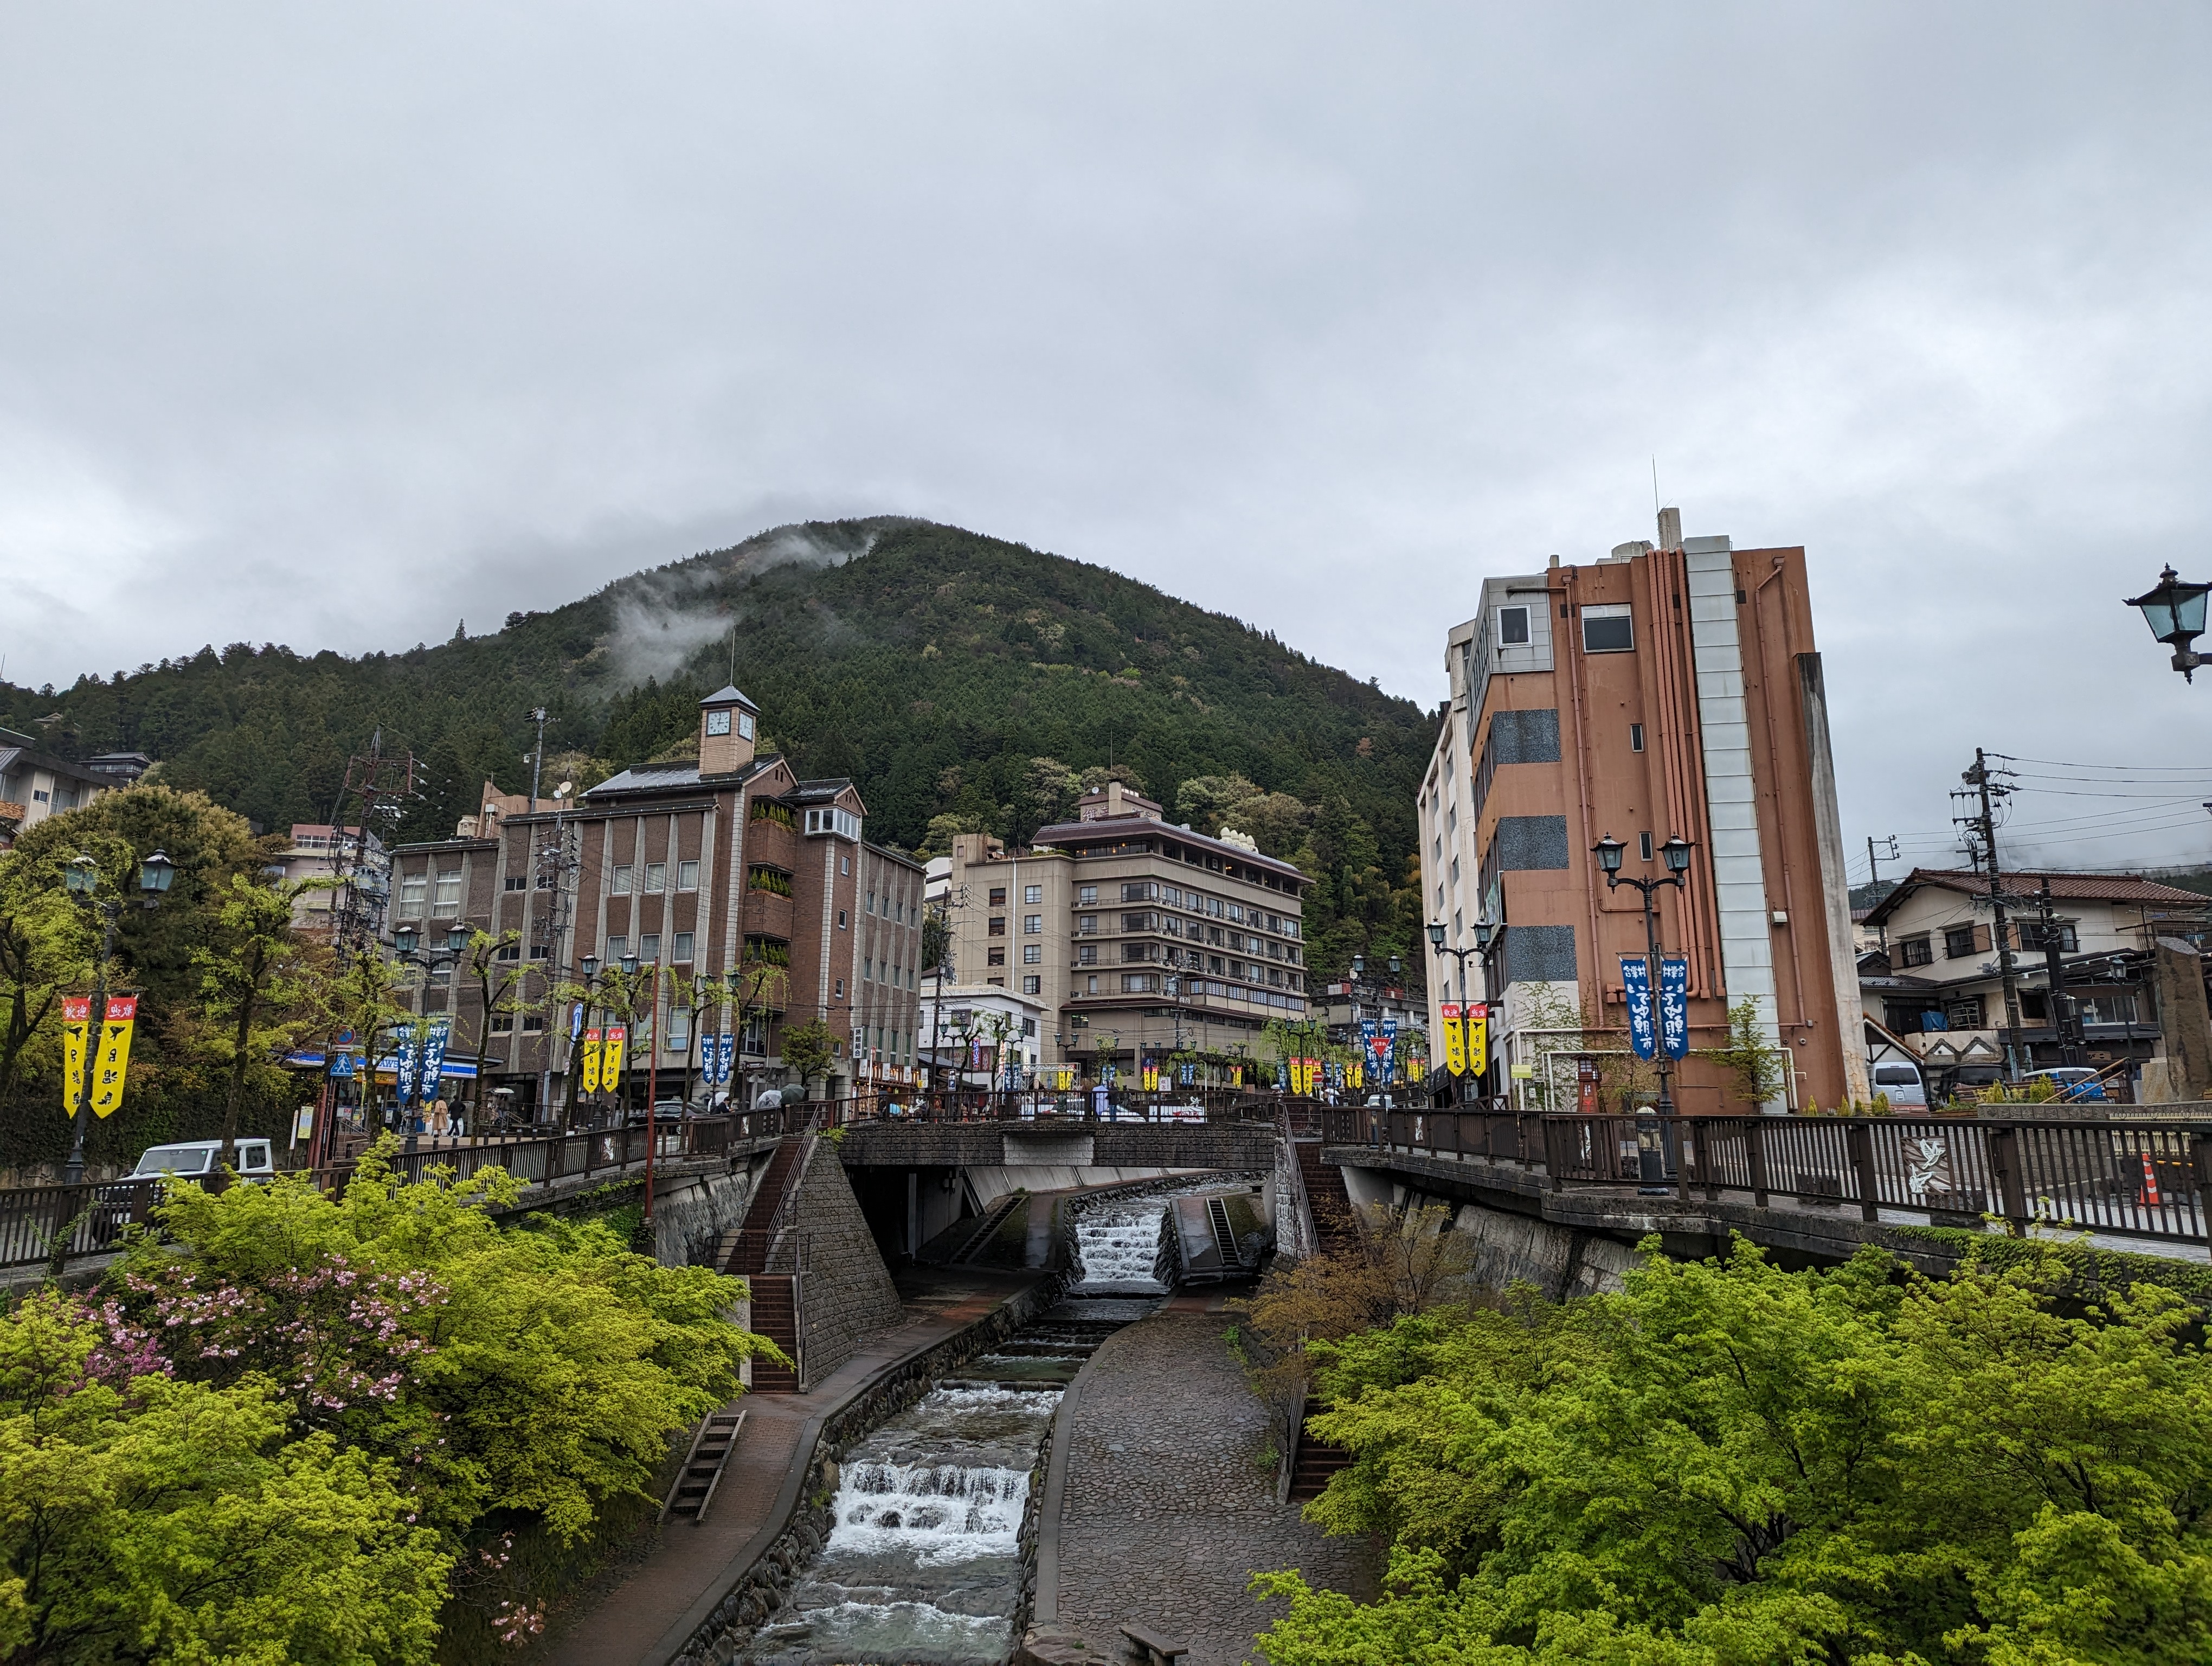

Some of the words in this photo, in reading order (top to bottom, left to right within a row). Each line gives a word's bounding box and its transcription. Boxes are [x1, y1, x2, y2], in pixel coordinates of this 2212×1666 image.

[1623, 964, 1646, 979] 合掌村
[66, 1005, 87, 1018] 歓迎
[1444, 1009, 1458, 1017] 歓迎
[1627, 984, 1652, 1049] いでゆ朝市
[1448, 1021, 1462, 1068] 下呂温泉
[703, 1047, 713, 1080] いでゆ朝市
